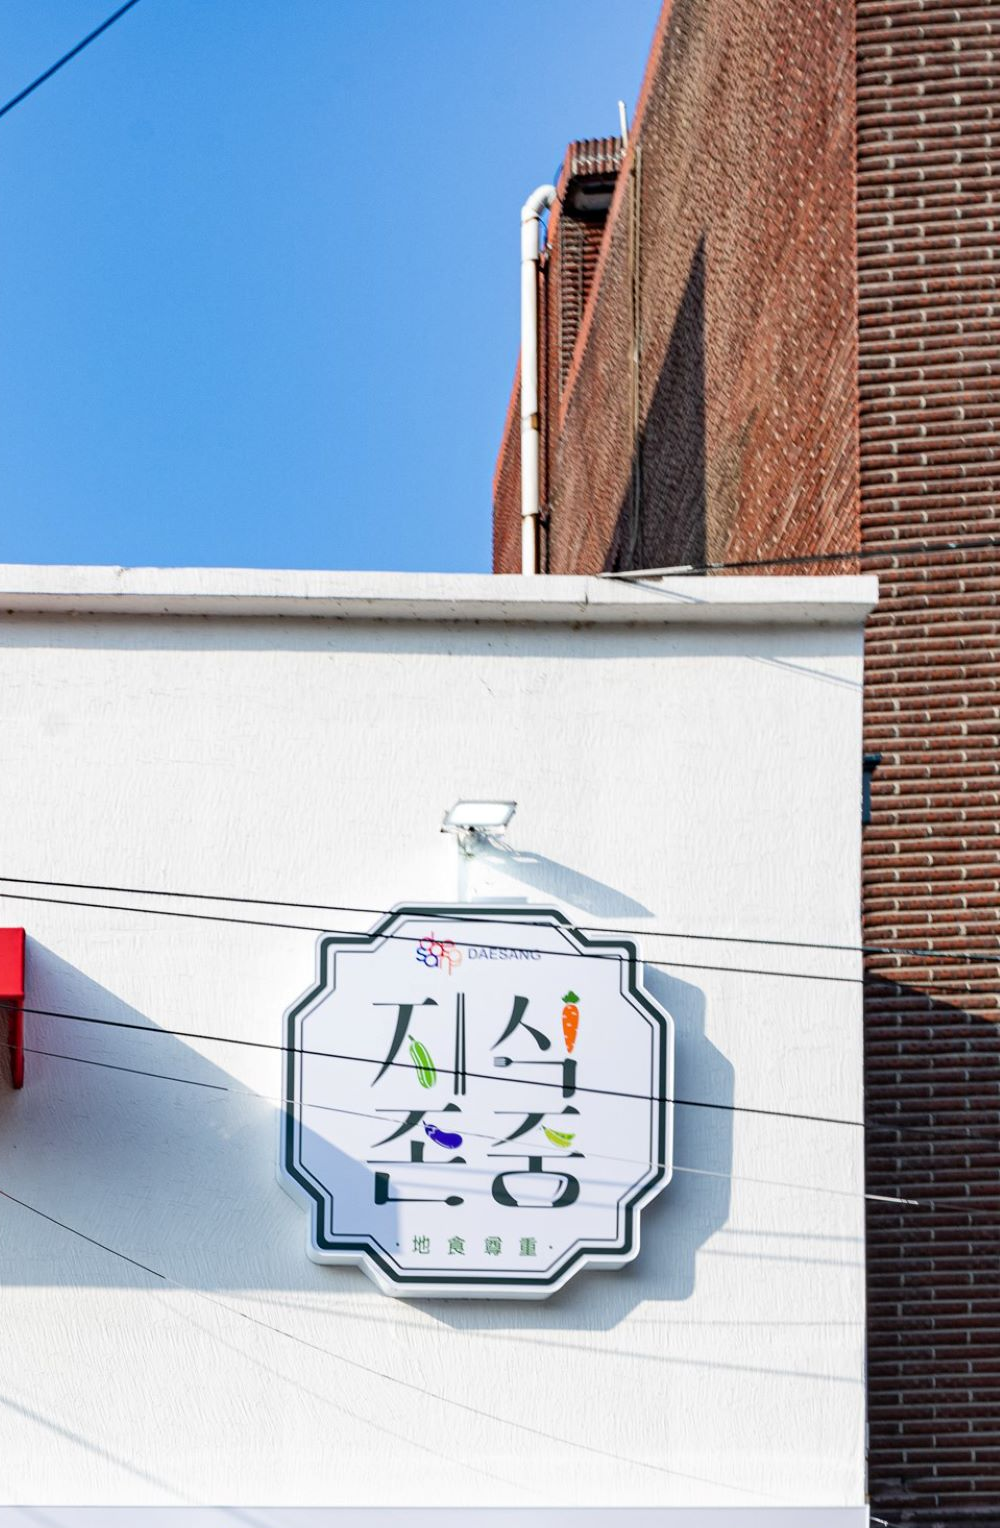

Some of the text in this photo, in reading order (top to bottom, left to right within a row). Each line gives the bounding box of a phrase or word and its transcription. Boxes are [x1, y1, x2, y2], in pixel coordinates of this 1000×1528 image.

[467, 947, 542, 960] DAESANG
[371, 990, 580, 1098] 지식
[367, 1103, 586, 1208] 존중
